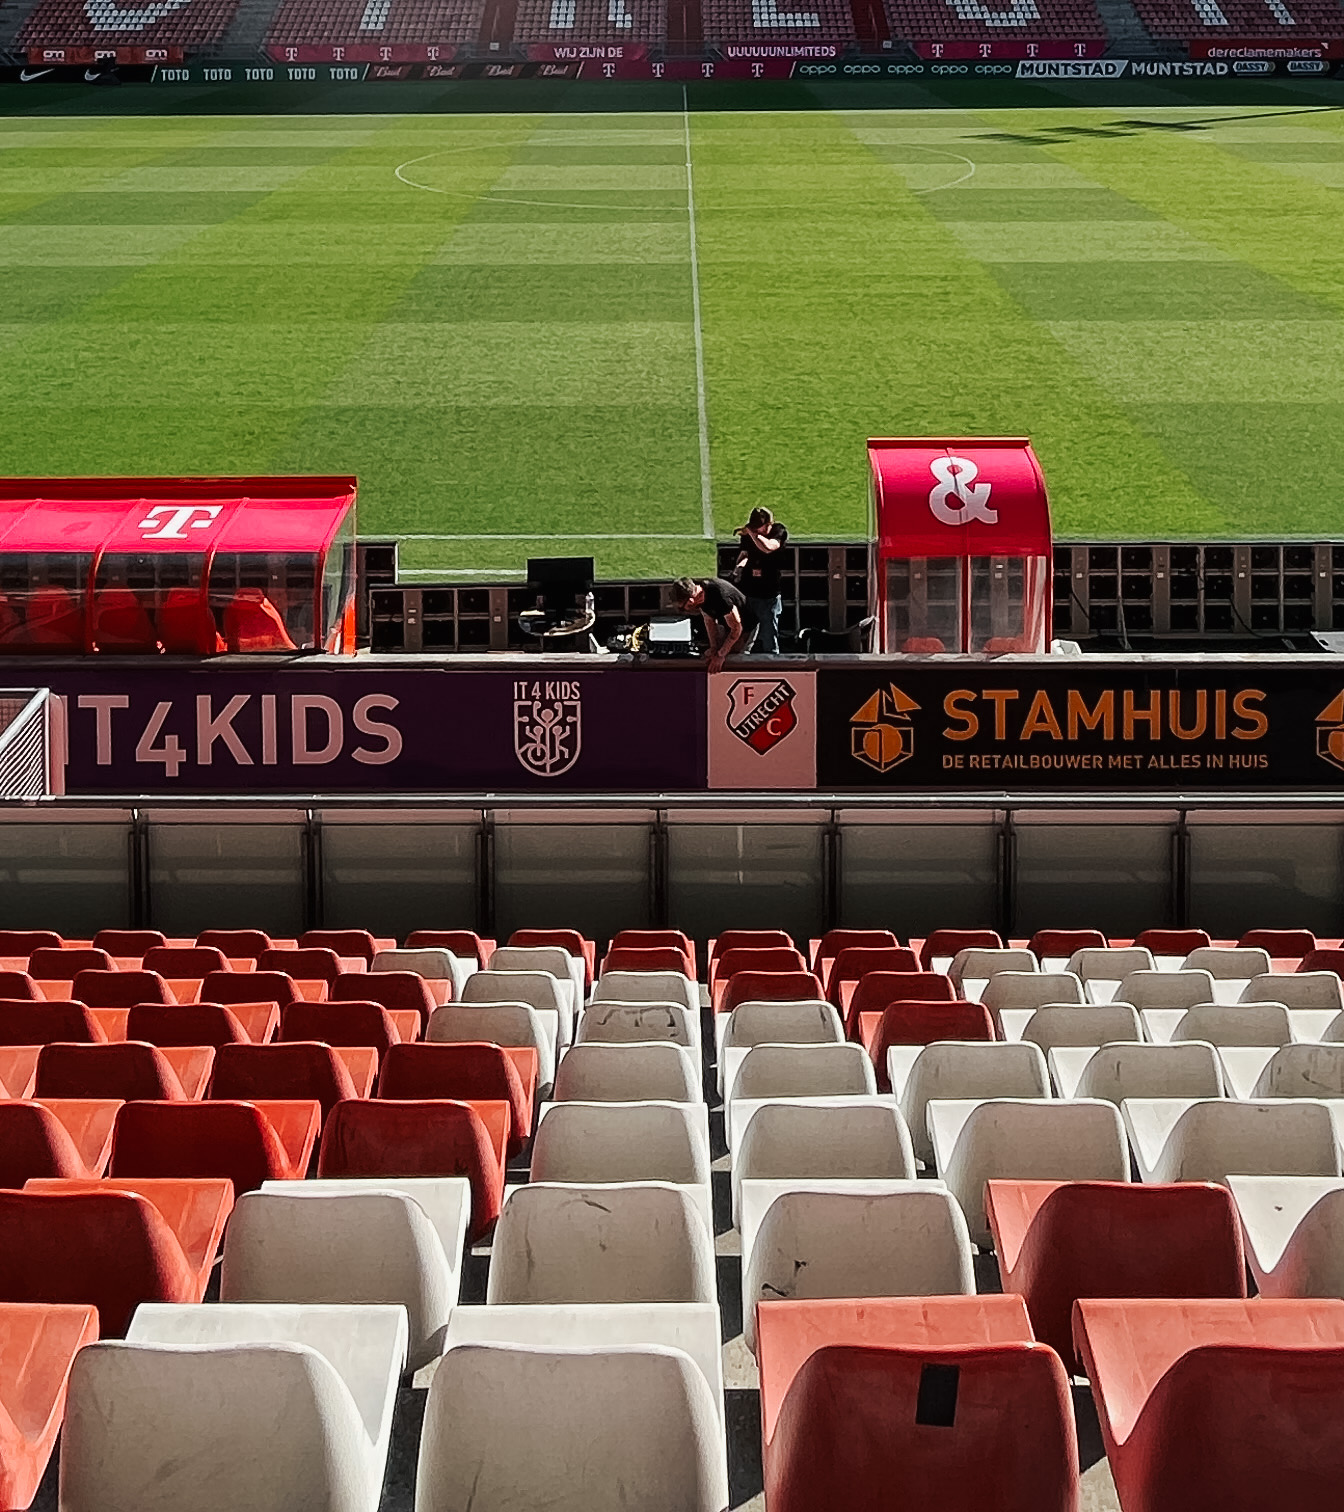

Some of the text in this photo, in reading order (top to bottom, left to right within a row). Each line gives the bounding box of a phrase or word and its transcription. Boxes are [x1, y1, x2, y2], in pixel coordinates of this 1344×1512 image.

[554, 47, 623, 58] WIJ ZIJN DE
[1208, 45, 1322, 58] dereclamemakers
[161, 69, 190, 81] TOTO
[203, 68, 232, 81] TOTO
[245, 68, 274, 81] TOTO
[288, 68, 316, 80] TOTO
[329, 67, 358, 80] TOTO
[799, 64, 837, 76] oppo
[843, 64, 881, 76] oppo
[887, 64, 925, 76] oppo
[931, 64, 969, 76] oppo
[974, 64, 1013, 75] oppo
[1020, 62, 1118, 76] MUNTSTAD
[1131, 62, 1228, 76] MUNTSTAD
[513, 681, 581, 700] IT 4 KIDS
[743, 686, 755, 705] F
[735, 684, 790, 738] UTRECHT
[942, 689, 1269, 741] STAMHUIS
[766, 717, 782, 736] C
[942, 754, 1269, 769] DE RETAILBOUWER MET ALLES IN HUIS
